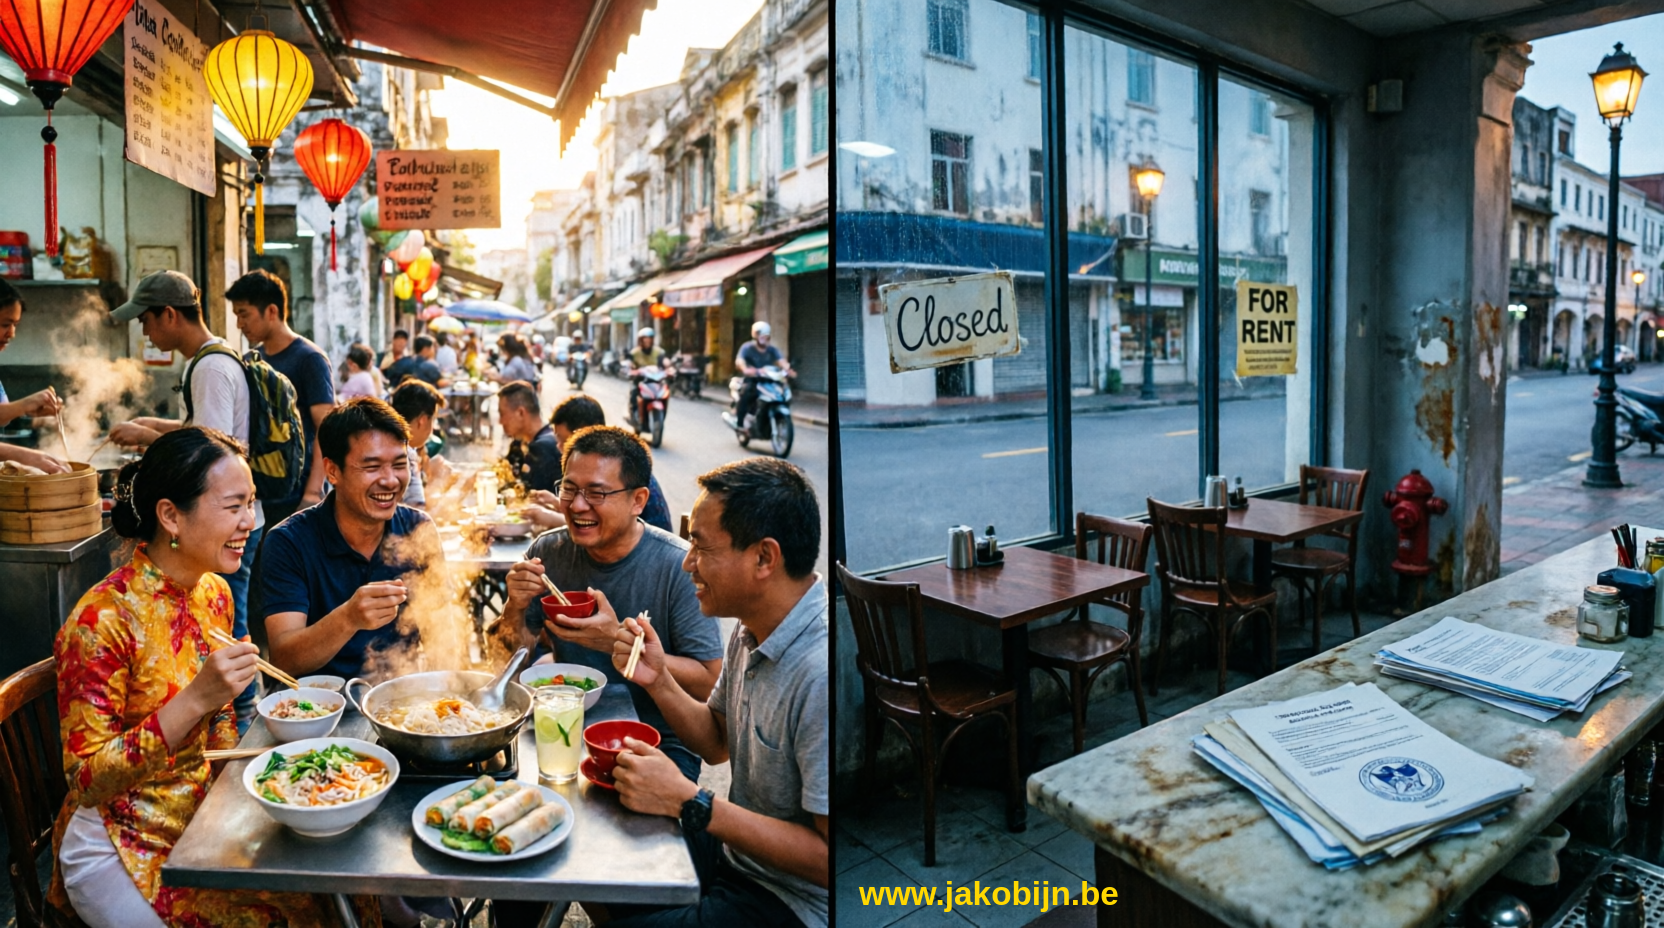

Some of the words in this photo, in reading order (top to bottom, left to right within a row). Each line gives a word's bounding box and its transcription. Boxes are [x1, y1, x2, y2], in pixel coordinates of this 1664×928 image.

[1248, 287, 1289, 314] FOR
[897, 286, 1009, 352] Closed
[1242, 319, 1296, 344] RENT
